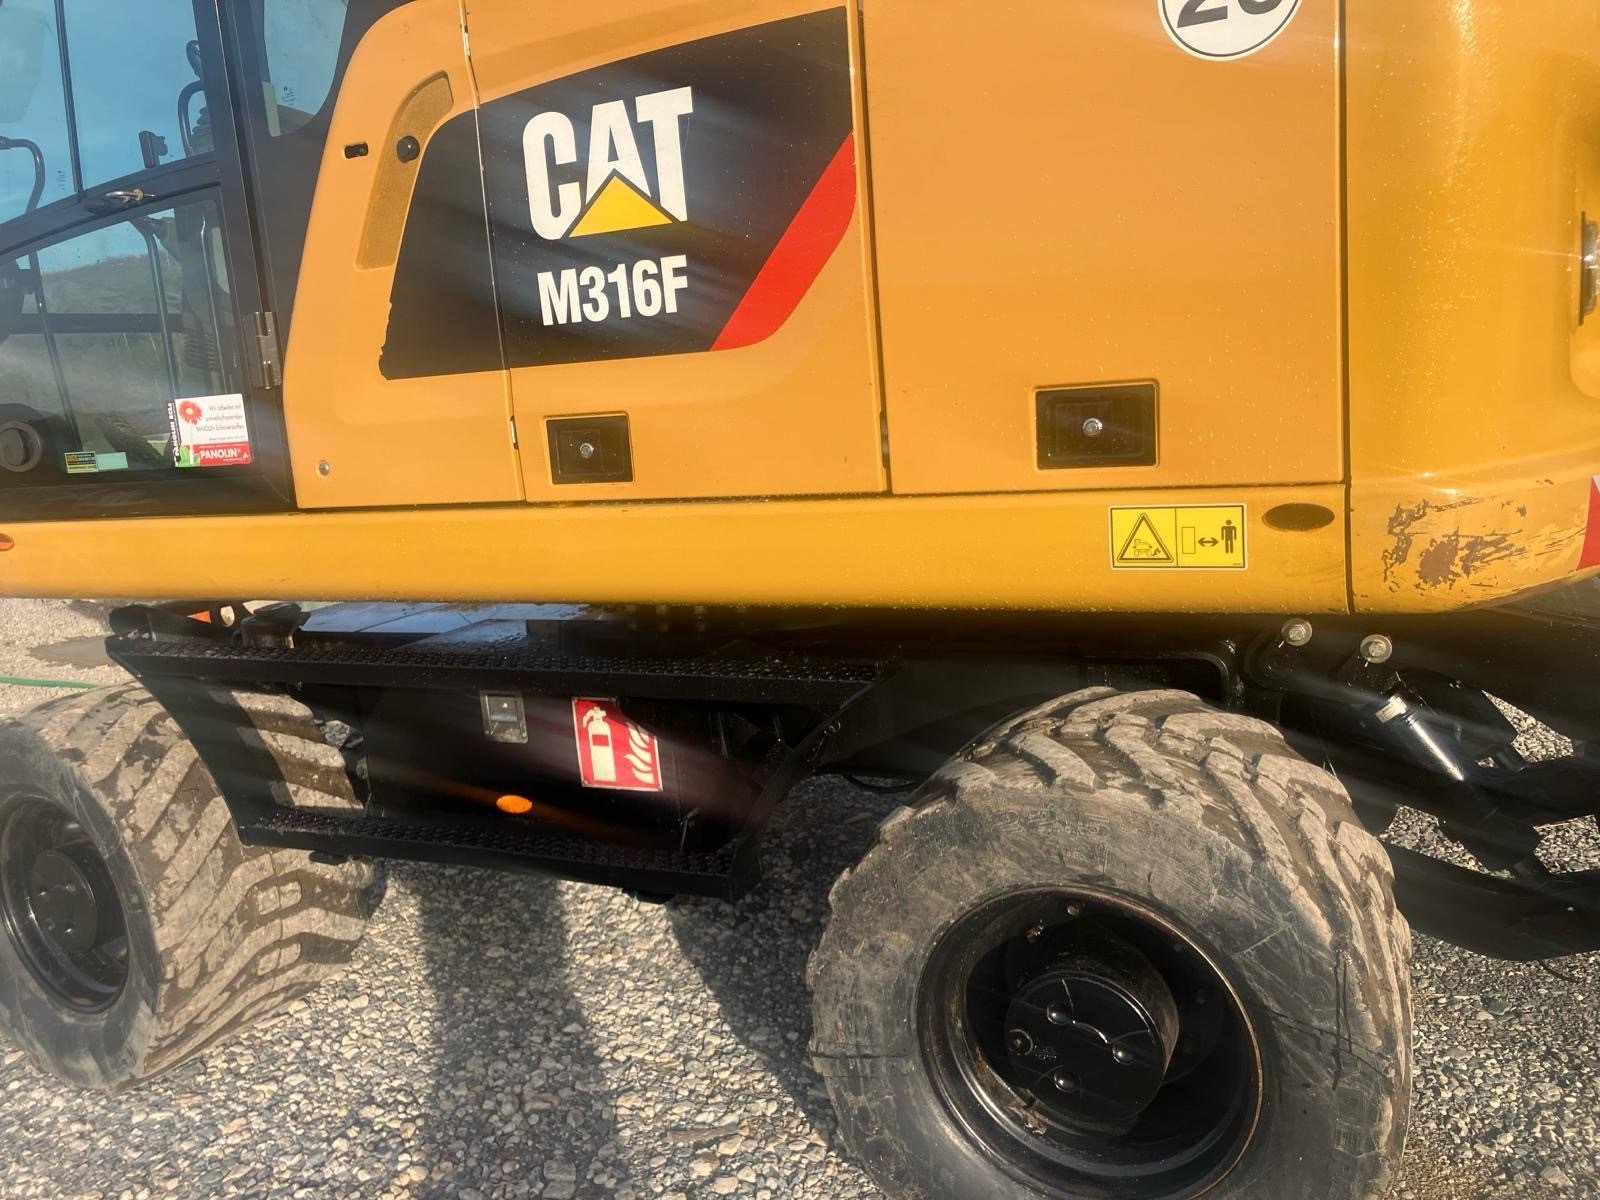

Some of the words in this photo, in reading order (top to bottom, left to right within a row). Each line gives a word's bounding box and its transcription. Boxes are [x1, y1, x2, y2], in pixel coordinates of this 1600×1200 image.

[523, 86, 694, 241] CAT
[537, 254, 689, 326] M316F
[200, 449, 237, 459] PANOLIN
